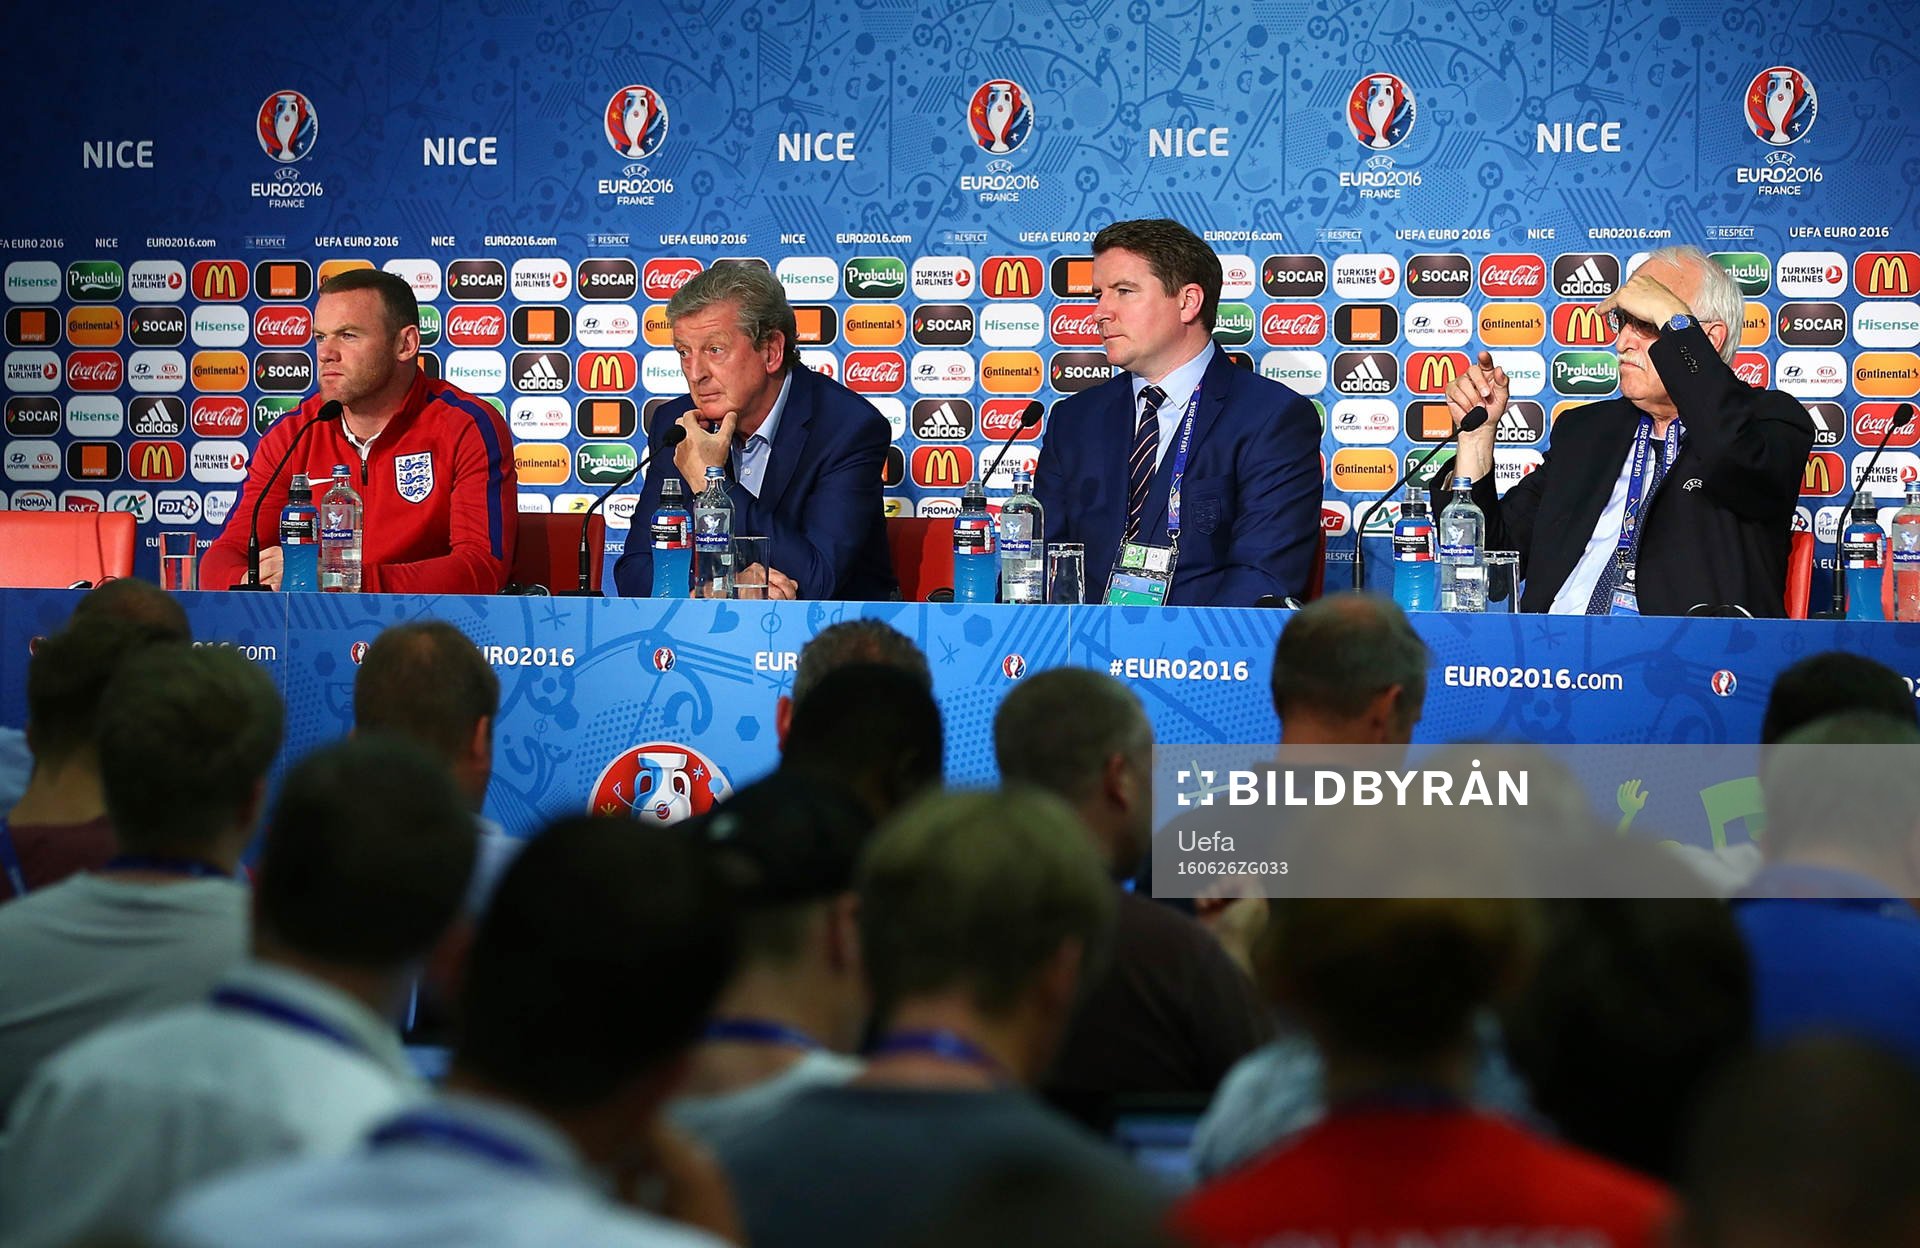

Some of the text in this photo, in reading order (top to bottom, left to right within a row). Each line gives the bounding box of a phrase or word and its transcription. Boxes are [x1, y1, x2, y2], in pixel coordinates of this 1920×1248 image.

[1149, 127, 1229, 157] NICE
[1536, 122, 1621, 152] NICE
[424, 137, 498, 166] NICE
[778, 132, 856, 161] NICE
[83, 140, 154, 168] NICE
[1765, 153, 1794, 165] UEFA
[985, 162, 1015, 173] UEFA
[1367, 157, 1395, 169] UEFA
[274, 169, 300, 180] UEFA
[622, 166, 650, 177] UEFA
[1736, 167, 1823, 183] EURO2016
[961, 175, 1039, 190] EURO2016
[1339, 171, 1422, 187] EURO2016
[251, 183, 323, 197] EURO2016
[598, 179, 674, 194] EURO2016
[1758, 186, 1801, 196] FRANCE
[980, 193, 1020, 202] FRANCE
[1360, 189, 1401, 199] FRANCE
[269, 200, 305, 208] FRANCE
[617, 196, 655, 206] FRANCE
[954, 233, 987, 242] RESPECT
[1019, 231, 1098, 242] UEFA EURO 20
[1203, 231, 1282, 242] EURO2016.com
[1327, 231, 1361, 240] RESPECT
[1396, 229, 1491, 240] UEFA EURO 2016
[1528, 228, 1554, 239] NICE
[1588, 229, 1671, 239] EURO2016.com
[1718, 228, 1754, 238] RESPECT
[1790, 226, 1889, 238] UEFA EURO 2016
[0, 238, 64, 248] FA EURO 2016
[95, 238, 118, 248] NICE
[146, 238, 216, 248] EURO2016.com
[255, 238, 286, 247] RESPECT
[315, 236, 399, 247] UEFA EURO 2016
[431, 236, 455, 246] NICE
[484, 235, 557, 246] EURO2016.com
[598, 235, 629, 245] RESPECT
[660, 234, 748, 245] UEFA EURO 2016
[781, 233, 806, 244] NICE
[836, 233, 912, 244] EURO2016.com
[515, 272, 550, 280] TURKISH
[848, 267, 904, 285] Probably
[916, 270, 953, 278] TURKISH
[1337, 268, 1377, 276] TURKISH
[1421, 269, 1469, 283] SOCAR
[1724, 264, 1768, 281] obably
[1781, 266, 1823, 275] TURKISH
[69, 270, 121, 287] Probably
[460, 274, 503, 287] SOCAR
[591, 273, 634, 286] SOCAR
[780, 273, 834, 285] Hisense
[915, 278, 953, 286] AIRLINES
[1277, 270, 1323, 283] SOCAR
[1337, 276, 1377, 284] AIRLINES
[1781, 275, 1823, 283] AIRLINES
[8, 277, 57, 288] Hisense
[131, 281, 166, 289] AIRLINES
[515, 280, 550, 288] AIRLINES
[1561, 280, 1611, 295] adidas
[270, 288, 294, 296] orange
[69, 320, 113, 332] Continental
[142, 320, 183, 333] SOCAR
[195, 321, 245, 332] Hisense
[847, 319, 895, 331] Continental
[926, 319, 972, 332] SOCAR
[984, 319, 1040, 331] Hisense
[1482, 317, 1534, 330] Continental
[1794, 317, 1843, 331] SOCAR
[1858, 318, 1919, 331] Hisense
[20, 333, 42, 341] orange
[529, 333, 554, 341] orange
[1352, 332, 1380, 340] orange
[8, 371, 42, 379] AIRLINES
[194, 364, 239, 377] Continental
[268, 365, 309, 378] SOCAR
[450, 366, 502, 378] Hisense
[646, 367, 684, 378] Hisen
[983, 367, 1032, 379] Continental
[1064, 365, 1110, 379] SOCAR
[1265, 366, 1322, 379] Hisense
[1507, 368, 1540, 379] ense
[1555, 361, 1617, 380] Probably
[1856, 368, 1910, 381] Continental
[518, 378, 563, 391] adidas
[1341, 379, 1391, 392] adidas
[1187, 401, 1197, 417] 2016
[18, 410, 58, 422] SOCAR
[70, 410, 119, 422] Hisense
[136, 423, 178, 434] adidas
[593, 426, 620, 434] orange
[919, 422, 966, 438] adidas
[1183, 417, 1193, 436] EURO
[1496, 427, 1536, 441] didas
[1666, 424, 1676, 465] EURO 2016
[1633, 424, 1650, 477] UEFA EURO 2016
[194, 462, 229, 470] AIRLINES
[579, 453, 635, 470] Probably
[82, 468, 105, 476] orange
[1335, 463, 1386, 476] Continental
[1495, 471, 1522, 479] LINES
[15, 499, 51, 508] PROMAN
[159, 502, 182, 514] FDJ
[609, 503, 634, 512] PROM
[921, 506, 962, 515] PROMAN
[1325, 552, 1354, 562] RESPEC
[1109, 658, 1250, 681] #EURO2016
[1444, 665, 1624, 690] EURO2016.com
